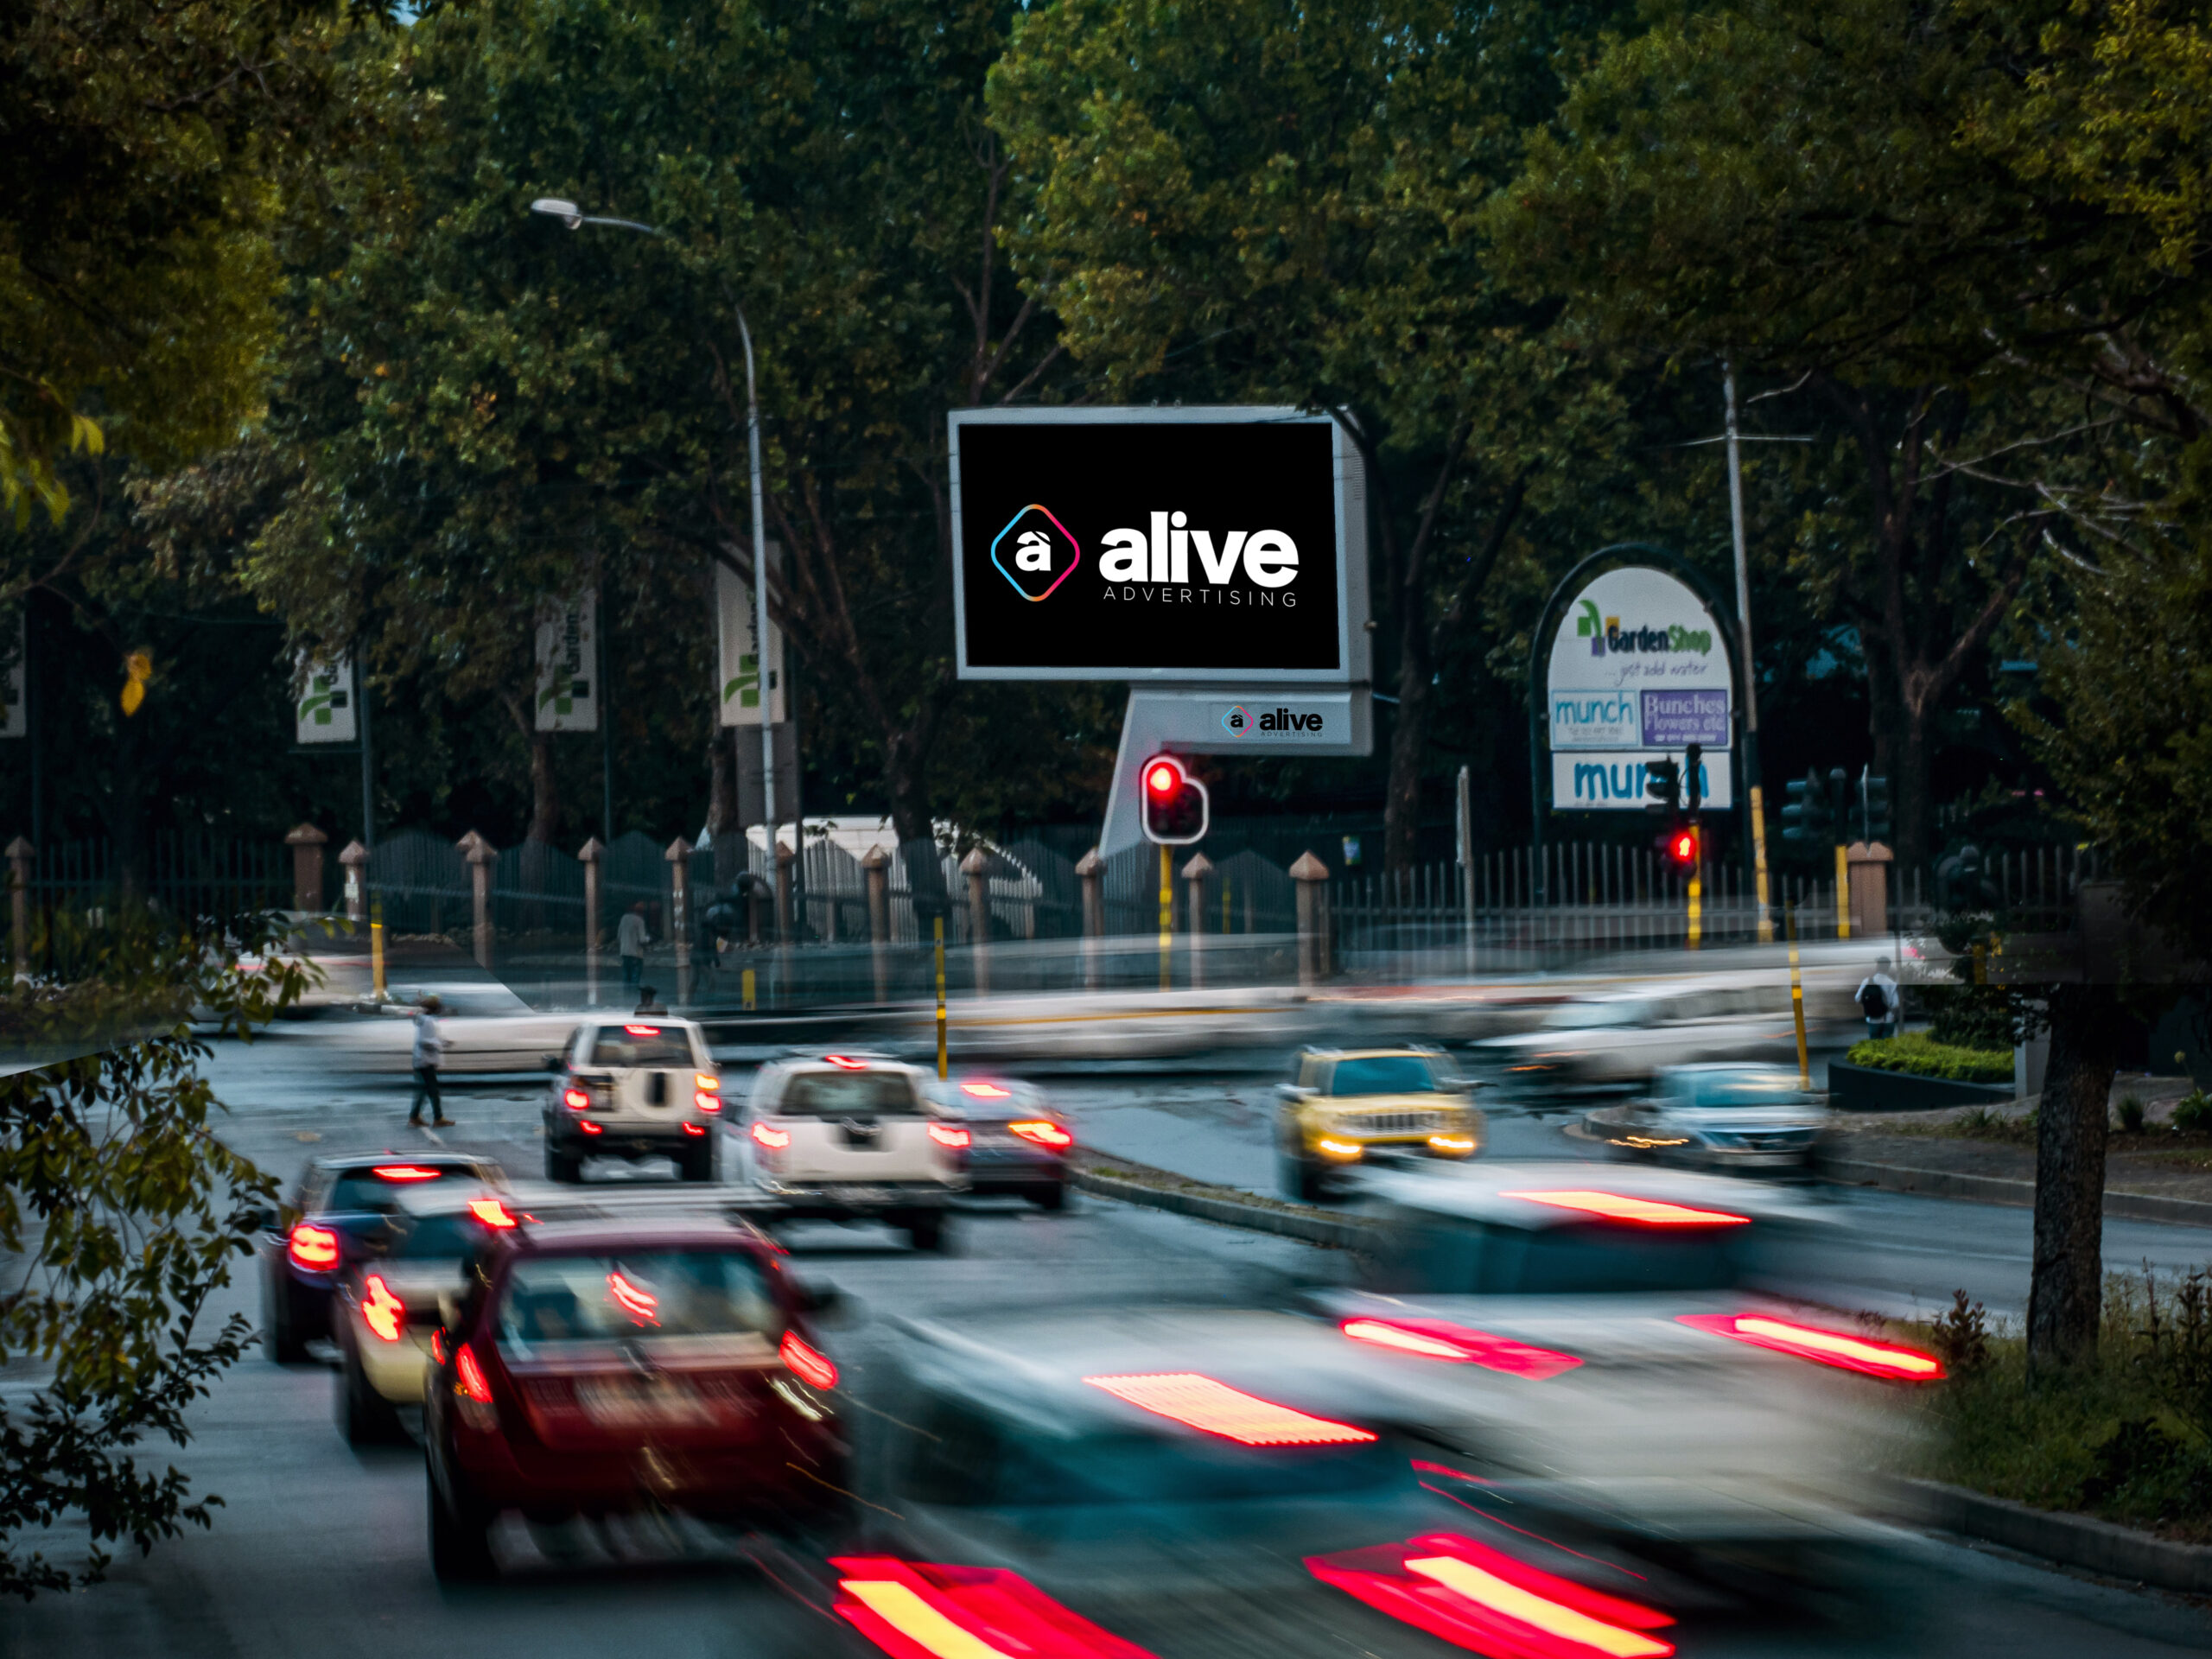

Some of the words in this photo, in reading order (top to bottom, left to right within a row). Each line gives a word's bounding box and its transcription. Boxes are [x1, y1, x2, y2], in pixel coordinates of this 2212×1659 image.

[1099, 511, 1300, 588] alive
[1103, 586, 1297, 607] ADVERTISING
[1556, 691, 1633, 725] munch
[1644, 694, 1726, 715] Bunches
[1259, 708, 1324, 731] alive
